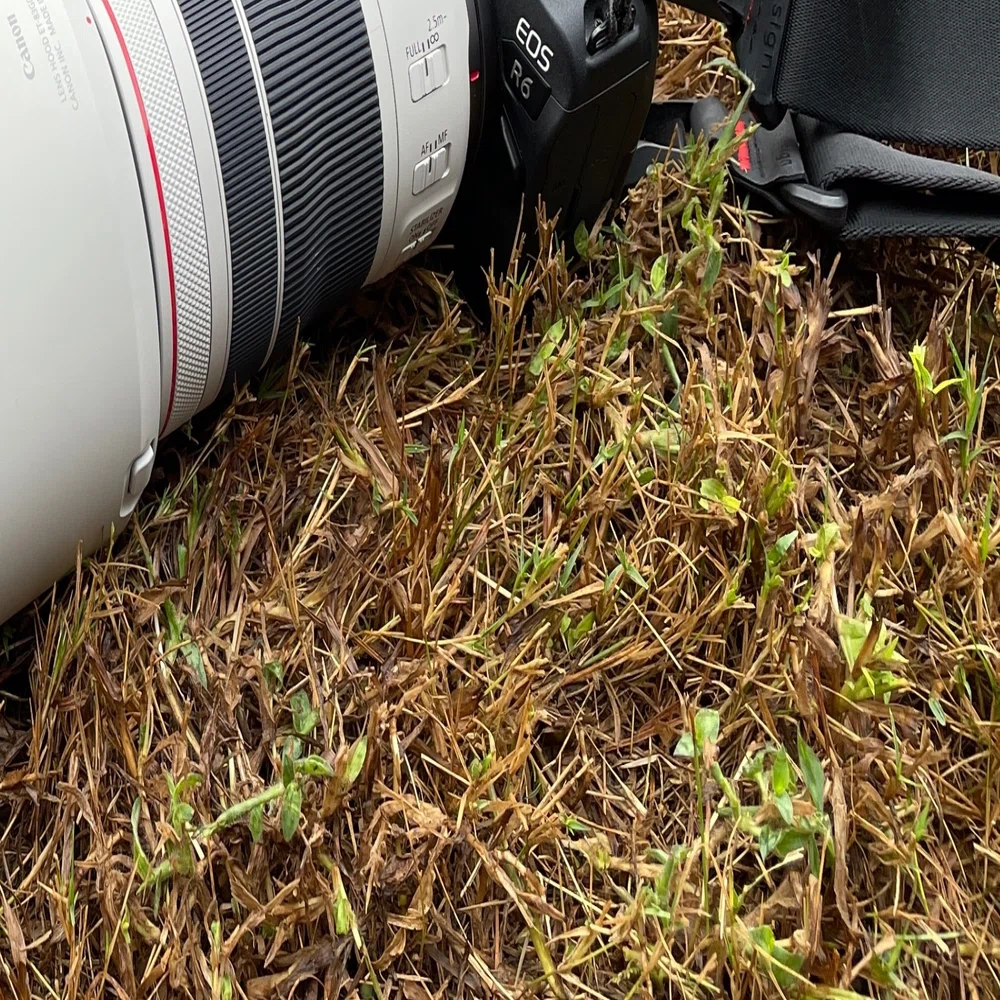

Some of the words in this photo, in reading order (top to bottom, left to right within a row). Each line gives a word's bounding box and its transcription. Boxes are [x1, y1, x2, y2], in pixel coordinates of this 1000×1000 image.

[40, 4, 56, 36] MADE
[7, 13, 35, 80] Canon
[42, 36, 57, 72] HOOD
[405, 40, 421, 60] FULL
[515, 16, 554, 73] EOS
[53, 73, 67, 103] LENS
[62, 65, 79, 111] CANON
[510, 58, 534, 100] R6
[421, 141, 429, 157] AF
[438, 128, 448, 145] MF
